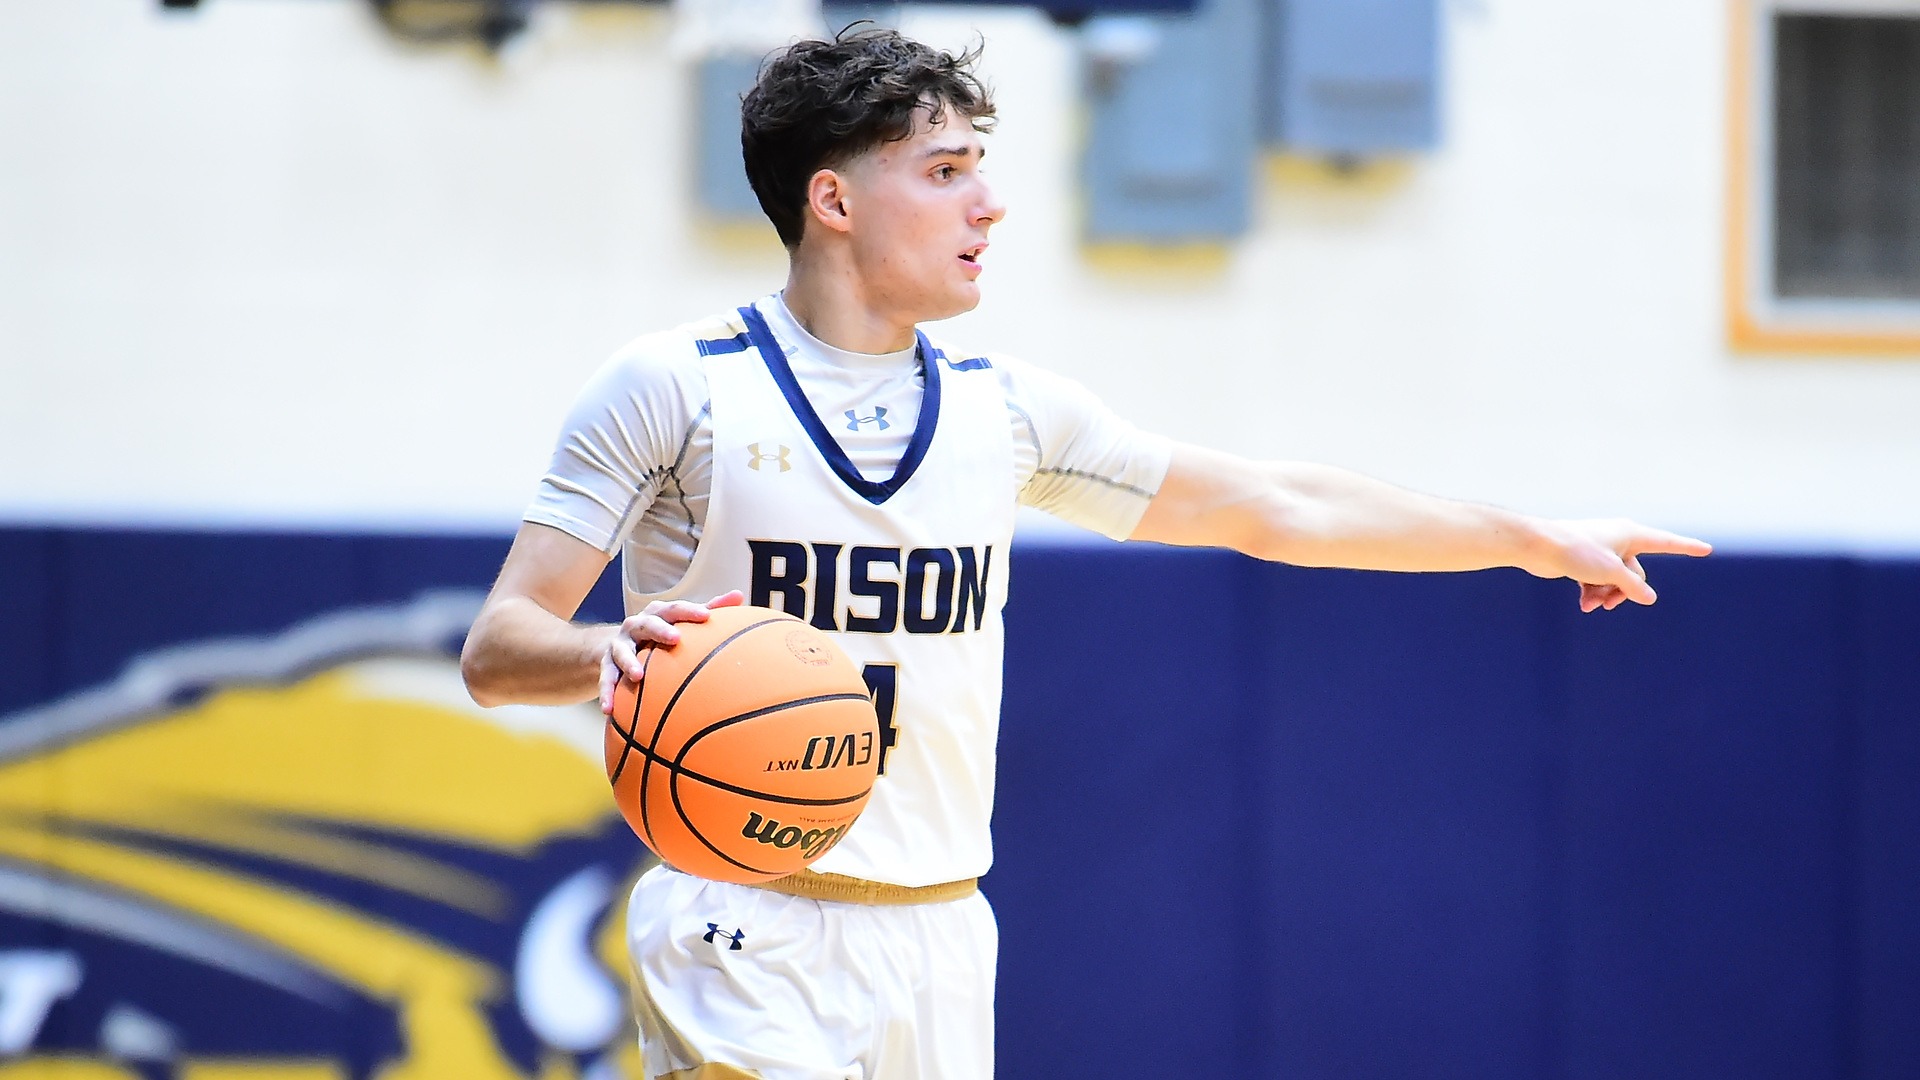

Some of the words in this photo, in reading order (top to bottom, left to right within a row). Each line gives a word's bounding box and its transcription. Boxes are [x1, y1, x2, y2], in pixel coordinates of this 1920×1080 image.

[746, 538, 992, 635] BISON
[763, 759, 799, 772] NXT
[801, 731, 873, 770] EVO
